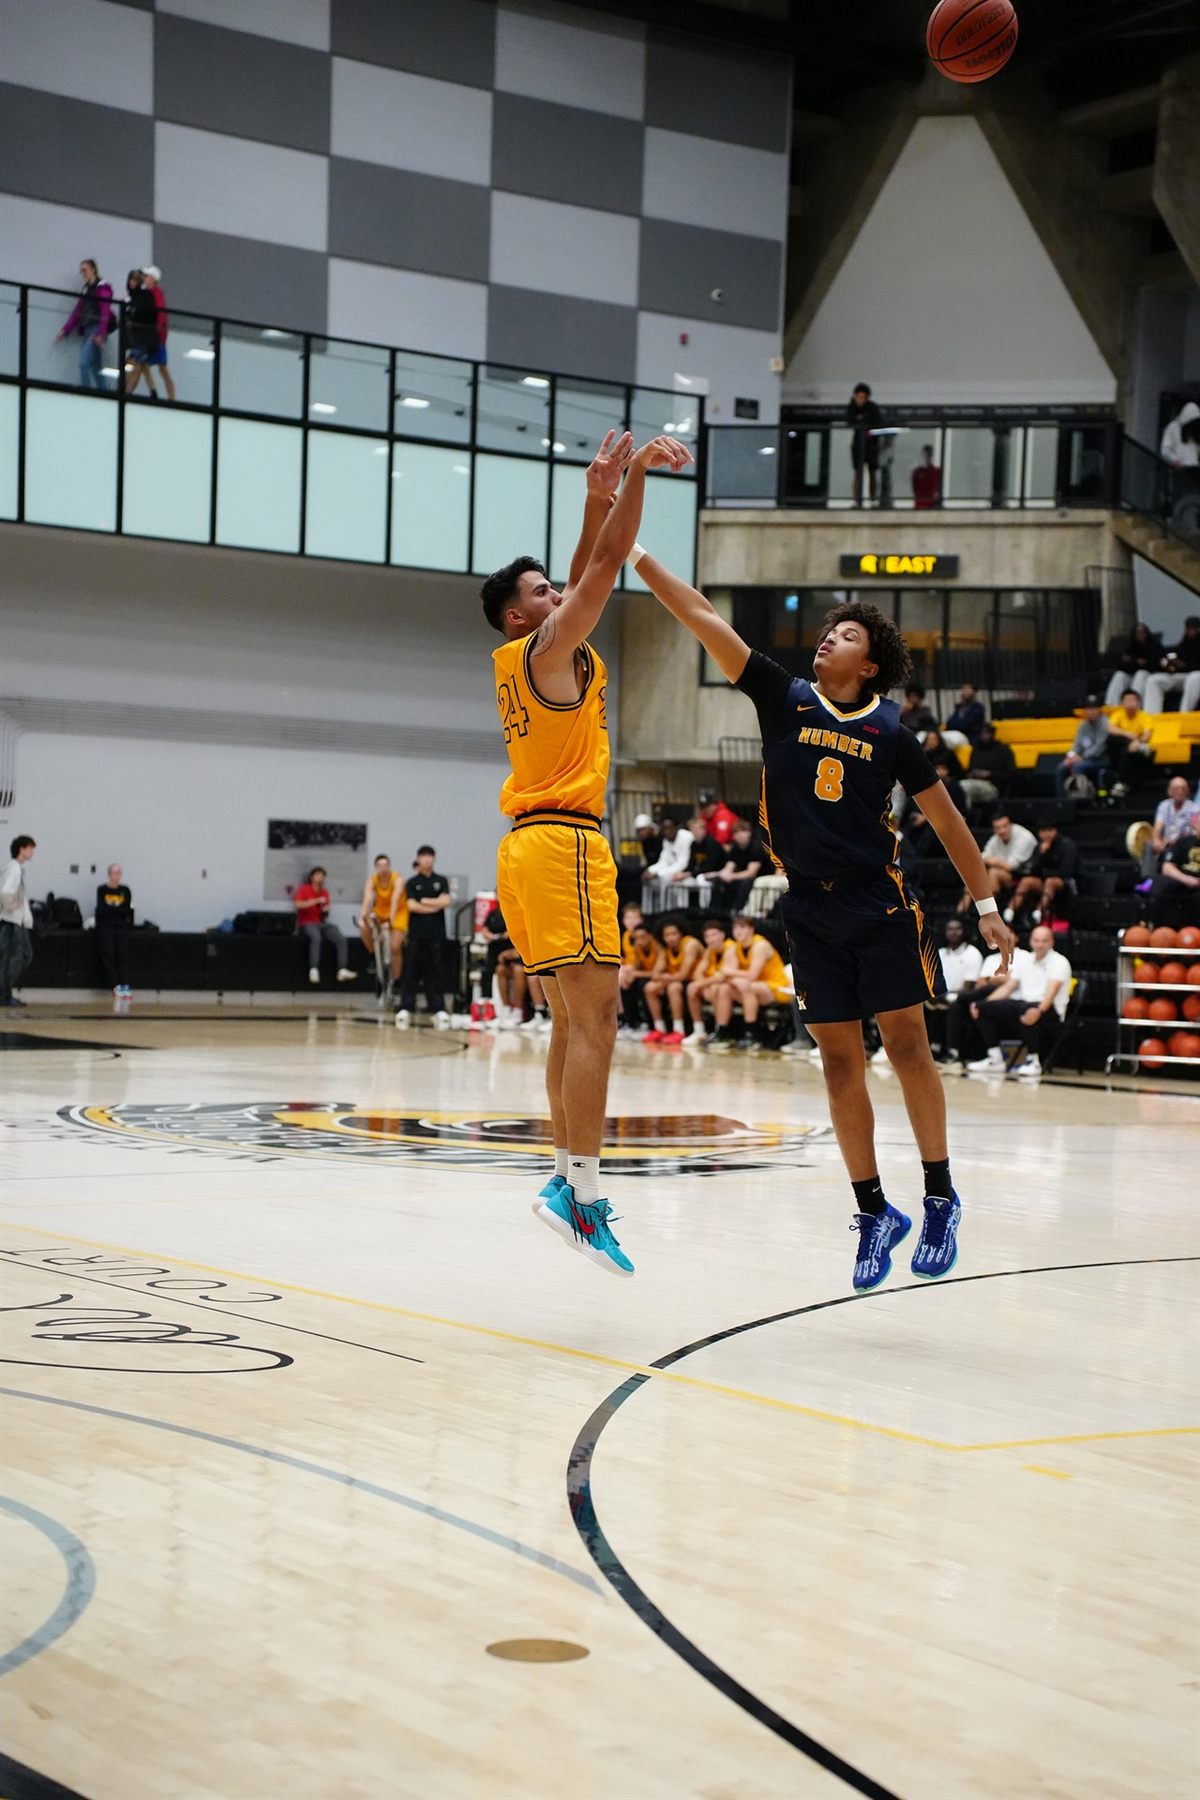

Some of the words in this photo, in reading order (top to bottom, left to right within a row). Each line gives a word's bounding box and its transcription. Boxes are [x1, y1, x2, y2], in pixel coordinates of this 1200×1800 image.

[885, 555, 937, 574] EAST
[498, 674, 530, 744] 24
[798, 726, 873, 761] HUMBER
[814, 756, 844, 802] 8
